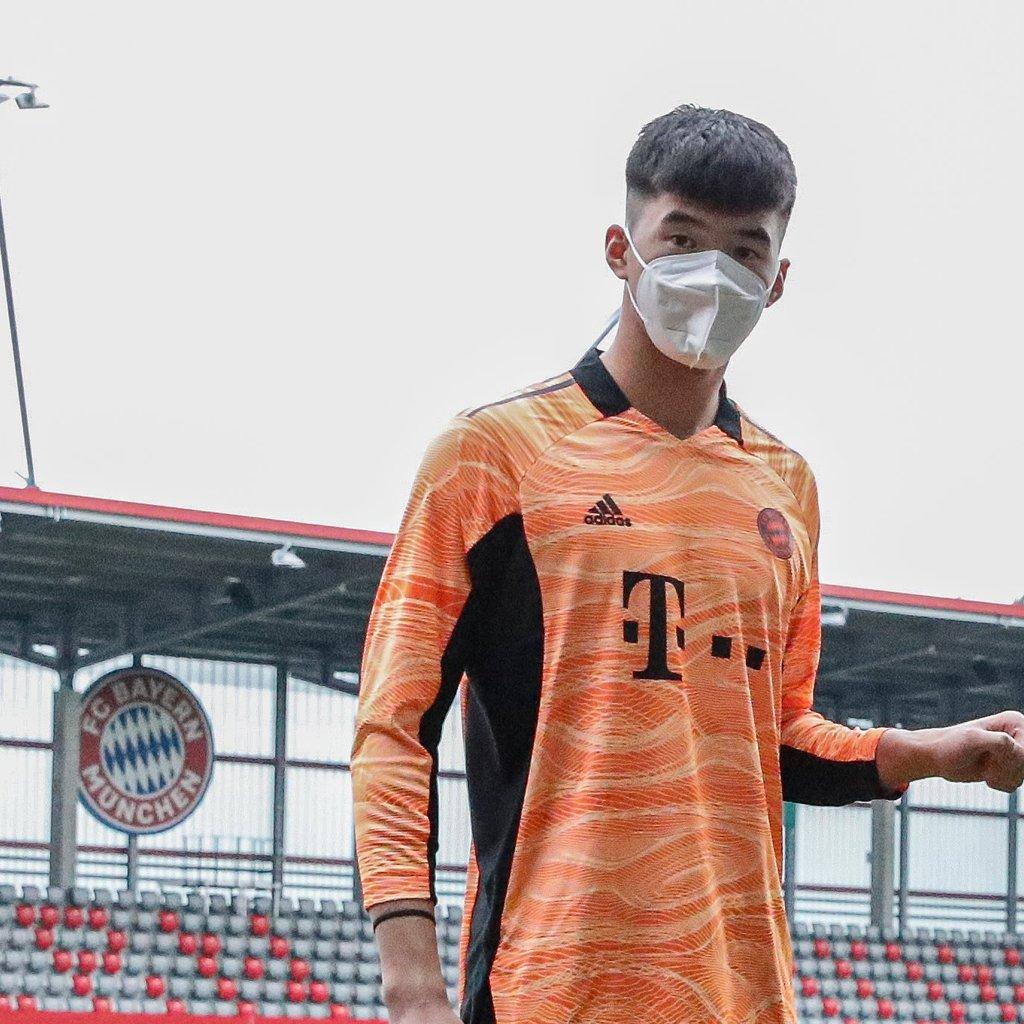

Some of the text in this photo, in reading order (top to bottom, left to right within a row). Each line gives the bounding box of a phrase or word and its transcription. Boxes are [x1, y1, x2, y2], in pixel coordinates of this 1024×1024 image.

[584, 514, 632, 528] adidas
[82, 677, 204, 741] FC BAYERN
